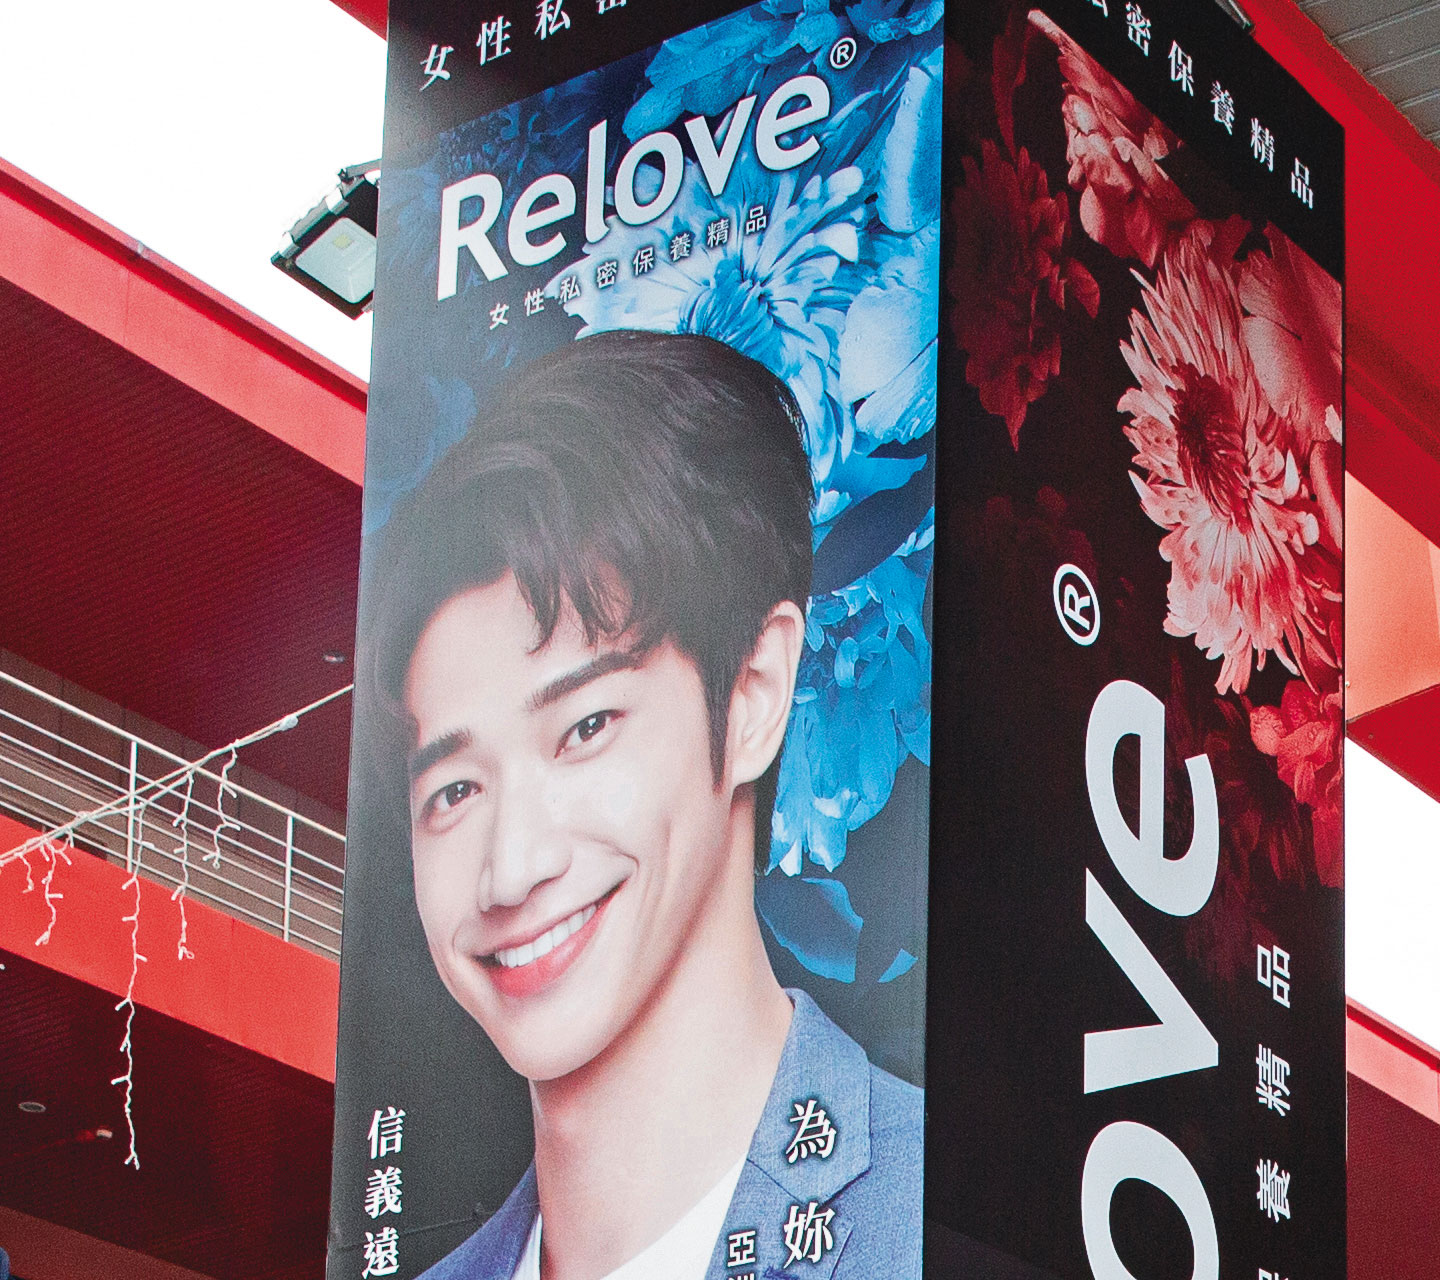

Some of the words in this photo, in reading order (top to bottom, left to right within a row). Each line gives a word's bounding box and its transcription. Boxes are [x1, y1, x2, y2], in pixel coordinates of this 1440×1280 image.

[419, 0, 627, 91] 女性私
[1092, 0, 1313, 209] 密保養精品
[489, 208, 767, 329] 女性私密保養精品
